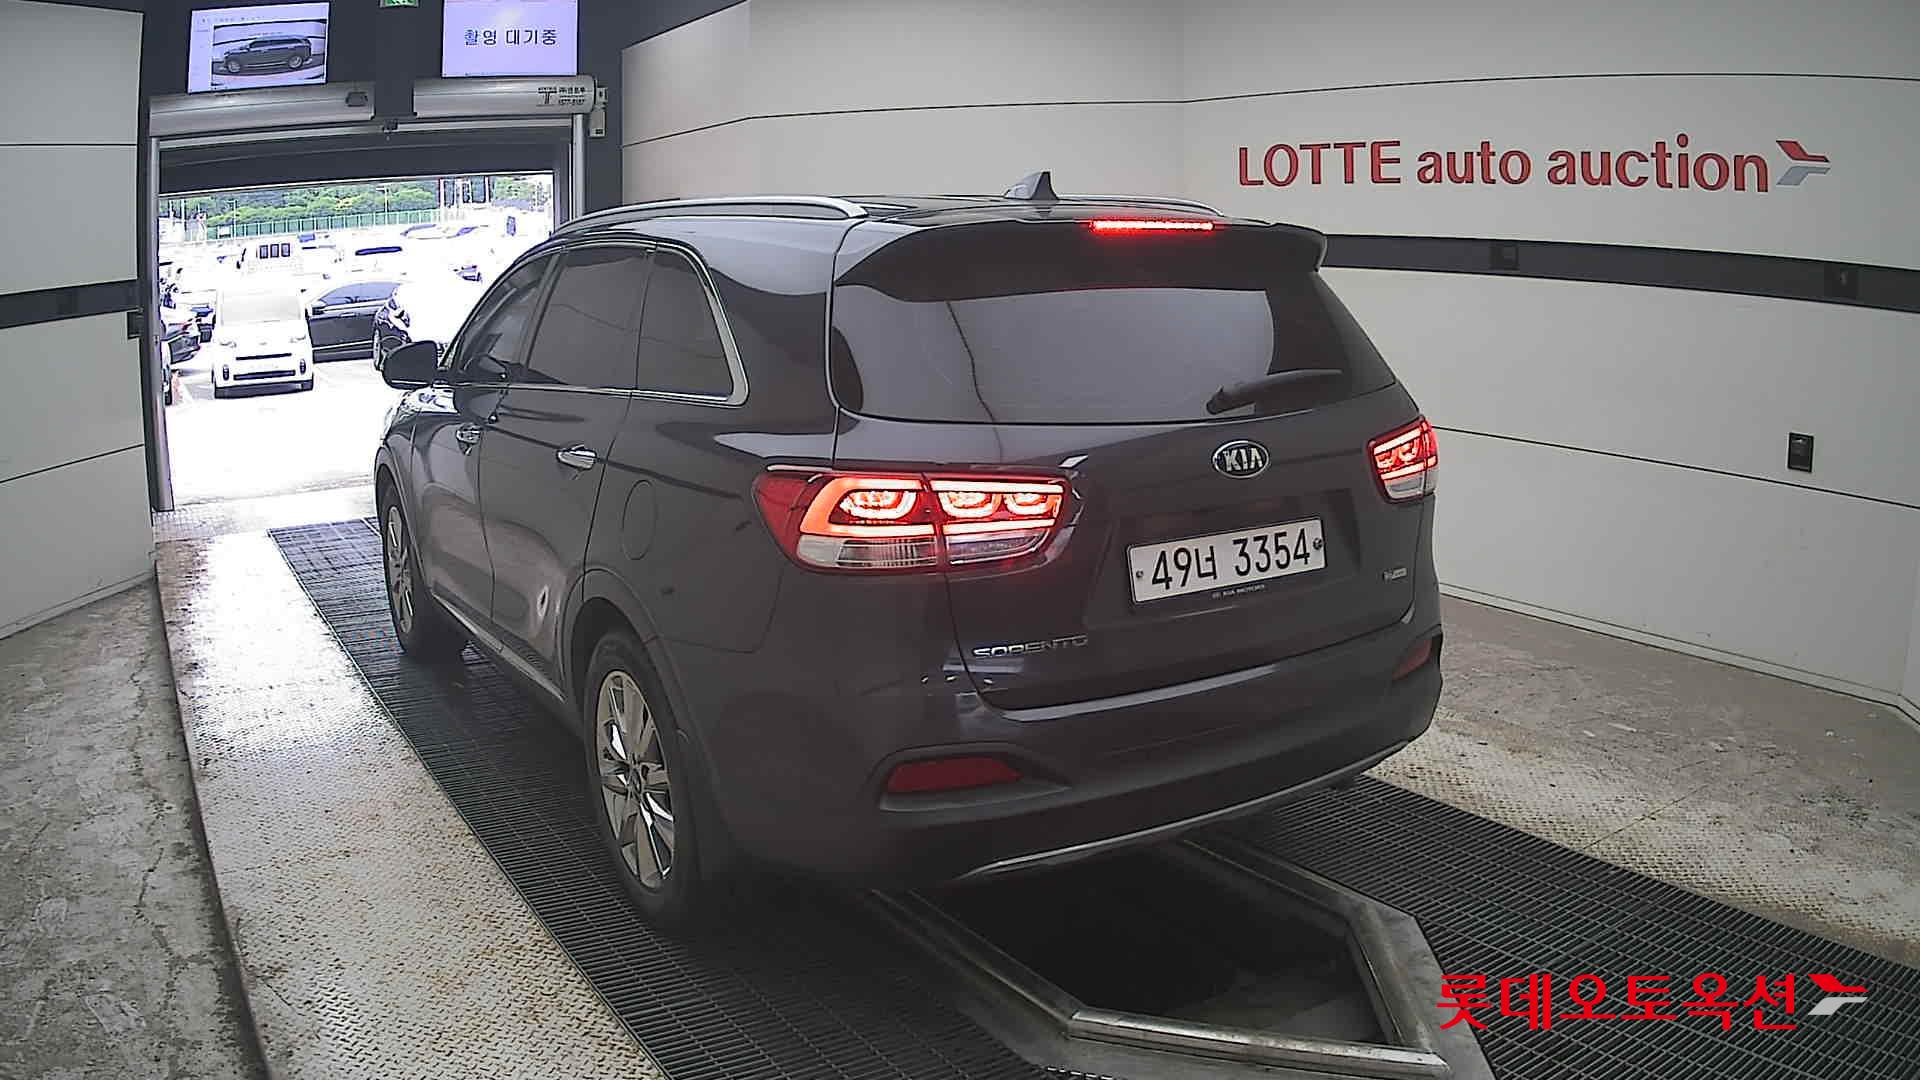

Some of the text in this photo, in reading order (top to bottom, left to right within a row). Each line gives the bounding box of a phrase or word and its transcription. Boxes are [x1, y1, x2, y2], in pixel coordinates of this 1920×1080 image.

[505, 29, 558, 46] 대기중
[1238, 133, 1769, 193] LOTTE auto auction
[1222, 447, 1264, 472] KIA
[1151, 527, 1311, 591] 49너 3354
[972, 634, 1089, 658] SORENTO
